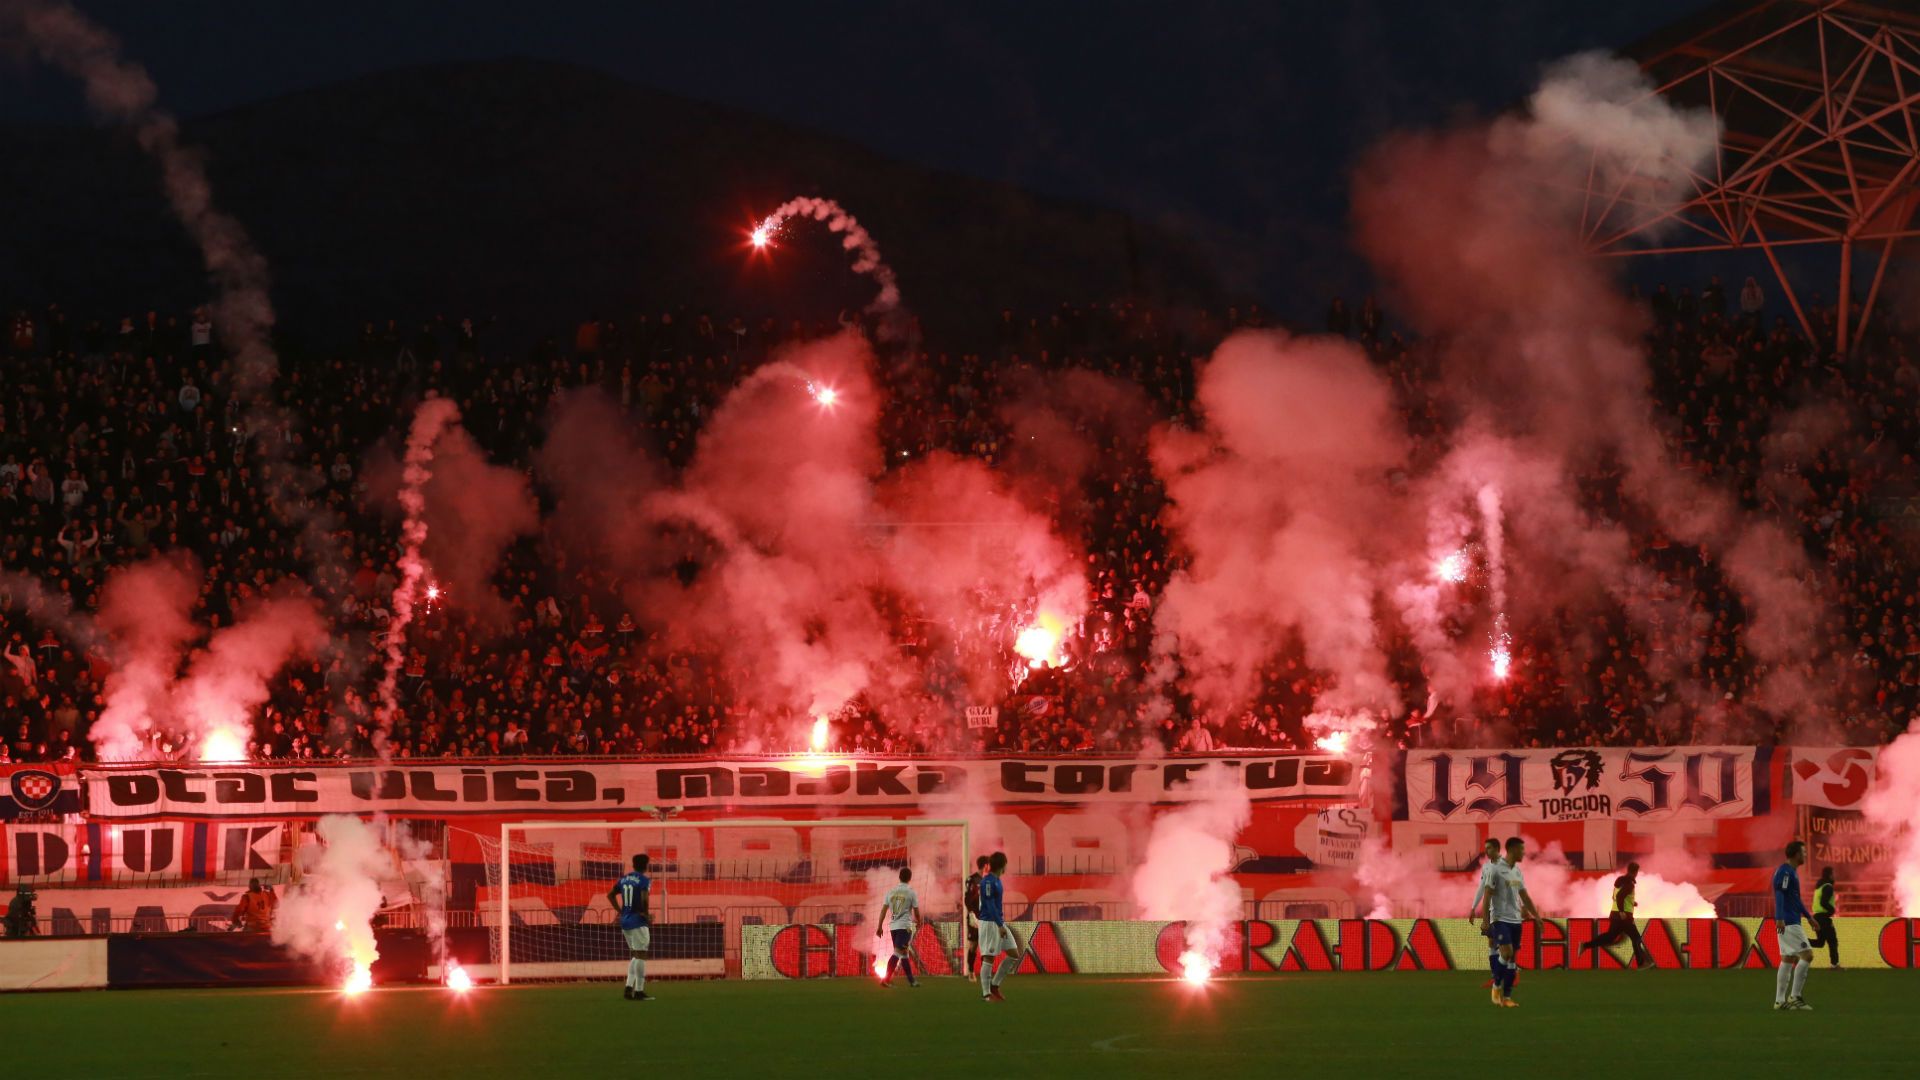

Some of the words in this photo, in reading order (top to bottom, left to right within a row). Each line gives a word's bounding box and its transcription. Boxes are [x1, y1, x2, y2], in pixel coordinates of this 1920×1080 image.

[1539, 794, 1611, 819] TORCIDA
[1558, 811, 1589, 820] SPLIT
[622, 884, 634, 907] 11
[770, 921, 1077, 979] GAA
